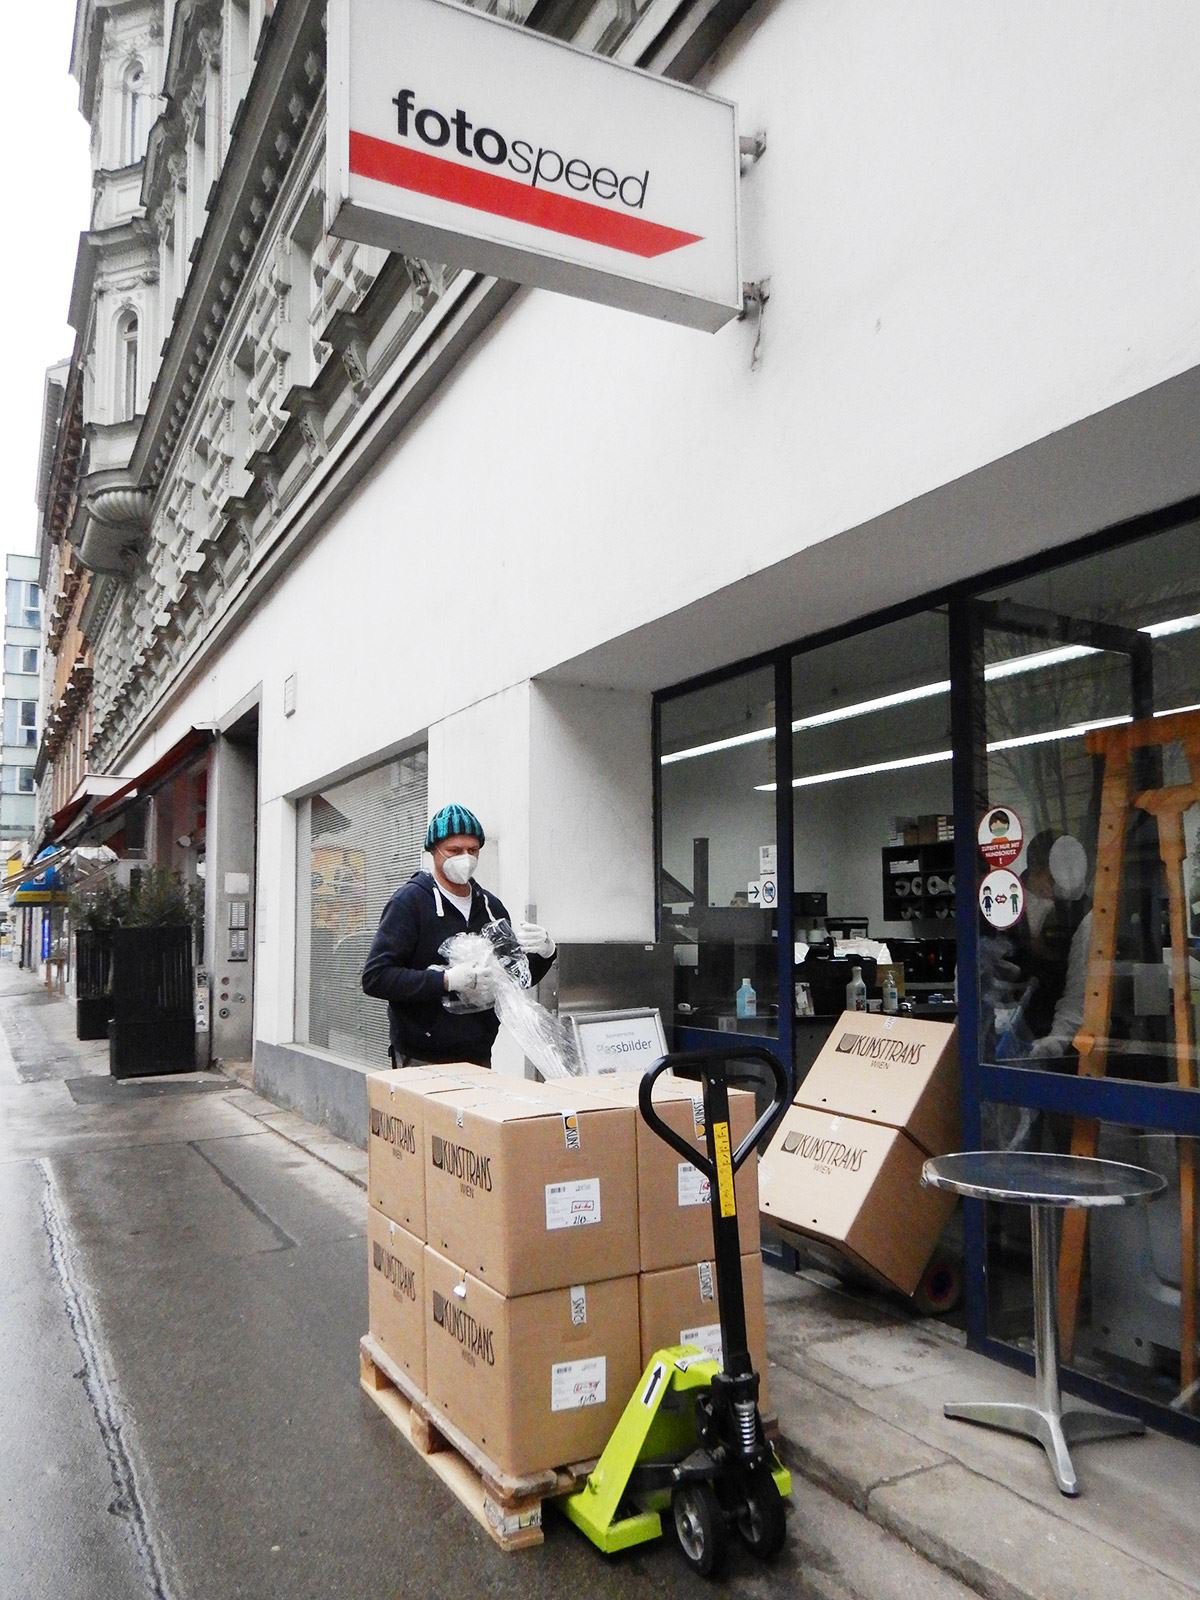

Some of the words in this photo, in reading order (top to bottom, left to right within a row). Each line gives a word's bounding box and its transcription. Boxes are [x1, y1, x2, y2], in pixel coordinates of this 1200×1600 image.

[392, 88, 650, 209] fotospeed
[851, 1034, 926, 1065] KUNSTTRANS
[871, 1060, 889, 1070] WIEN
[380, 1111, 416, 1155] KUNSTTRANS
[795, 1134, 868, 1172] KUNSTTRANS
[441, 1139, 493, 1192] KUNSTTRANS
[381, 1247, 416, 1302] KUNSTTRANS
[443, 1299, 495, 1366] KUNSTTRANS
